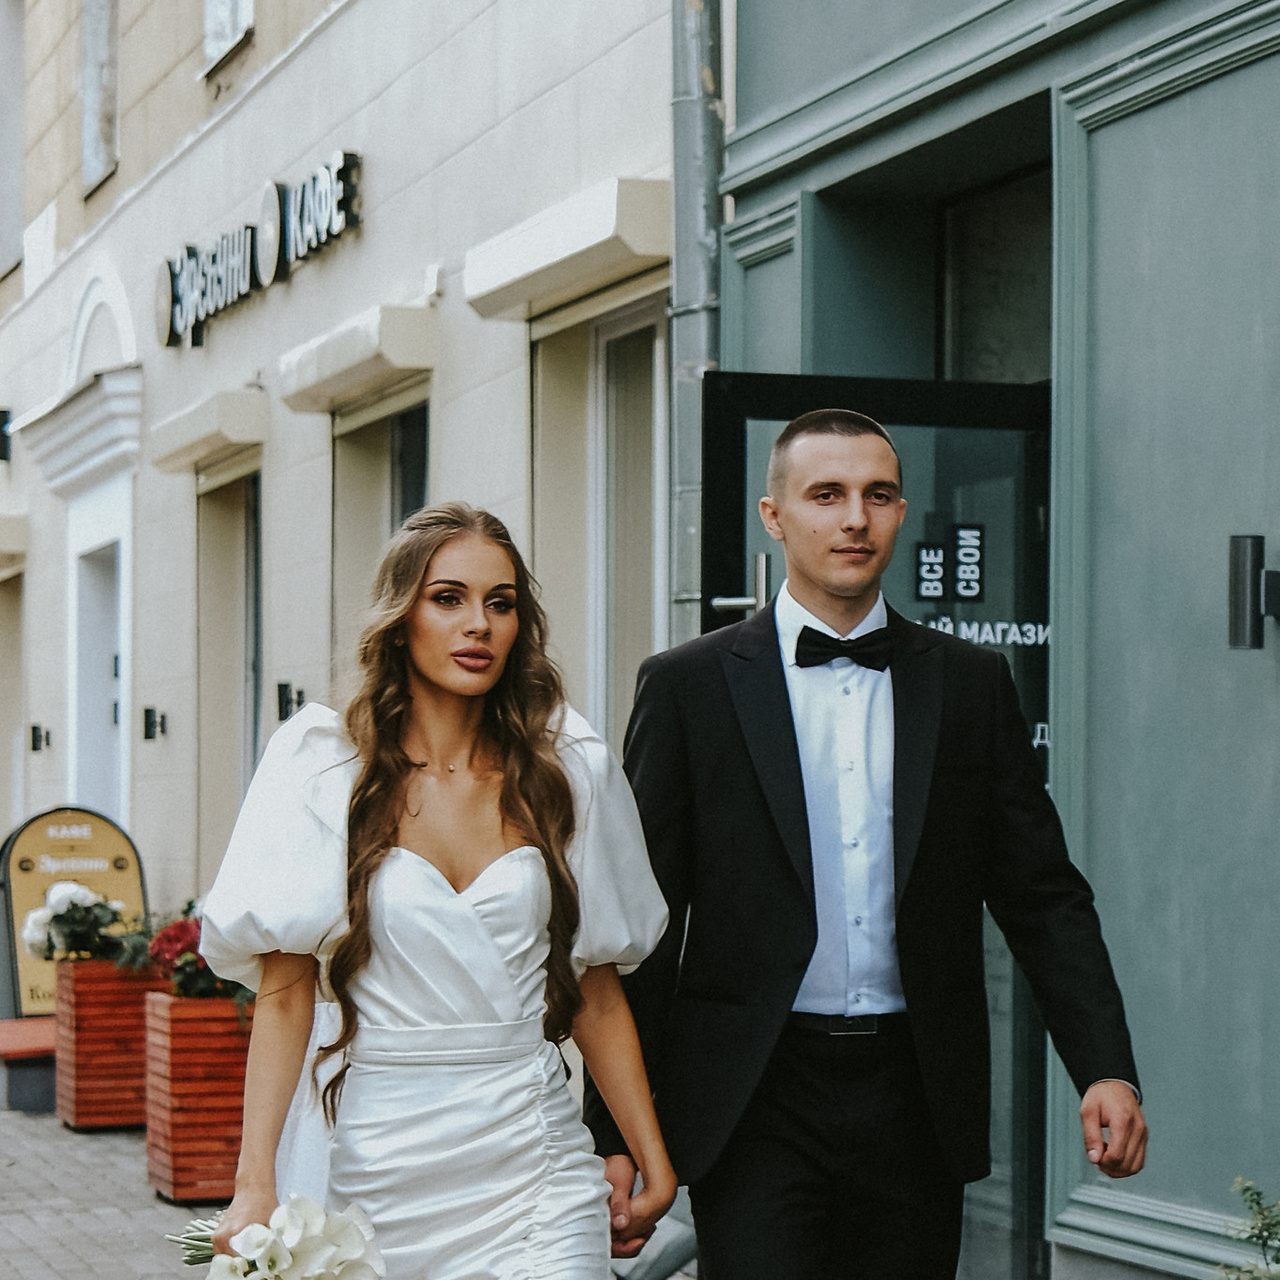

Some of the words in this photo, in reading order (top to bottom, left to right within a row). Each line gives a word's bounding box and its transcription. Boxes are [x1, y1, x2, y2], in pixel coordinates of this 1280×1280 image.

[288, 150, 349, 263] КАФЕ
[920, 549, 944, 597] ВСЕ
[957, 529, 980, 597] СВОИ
